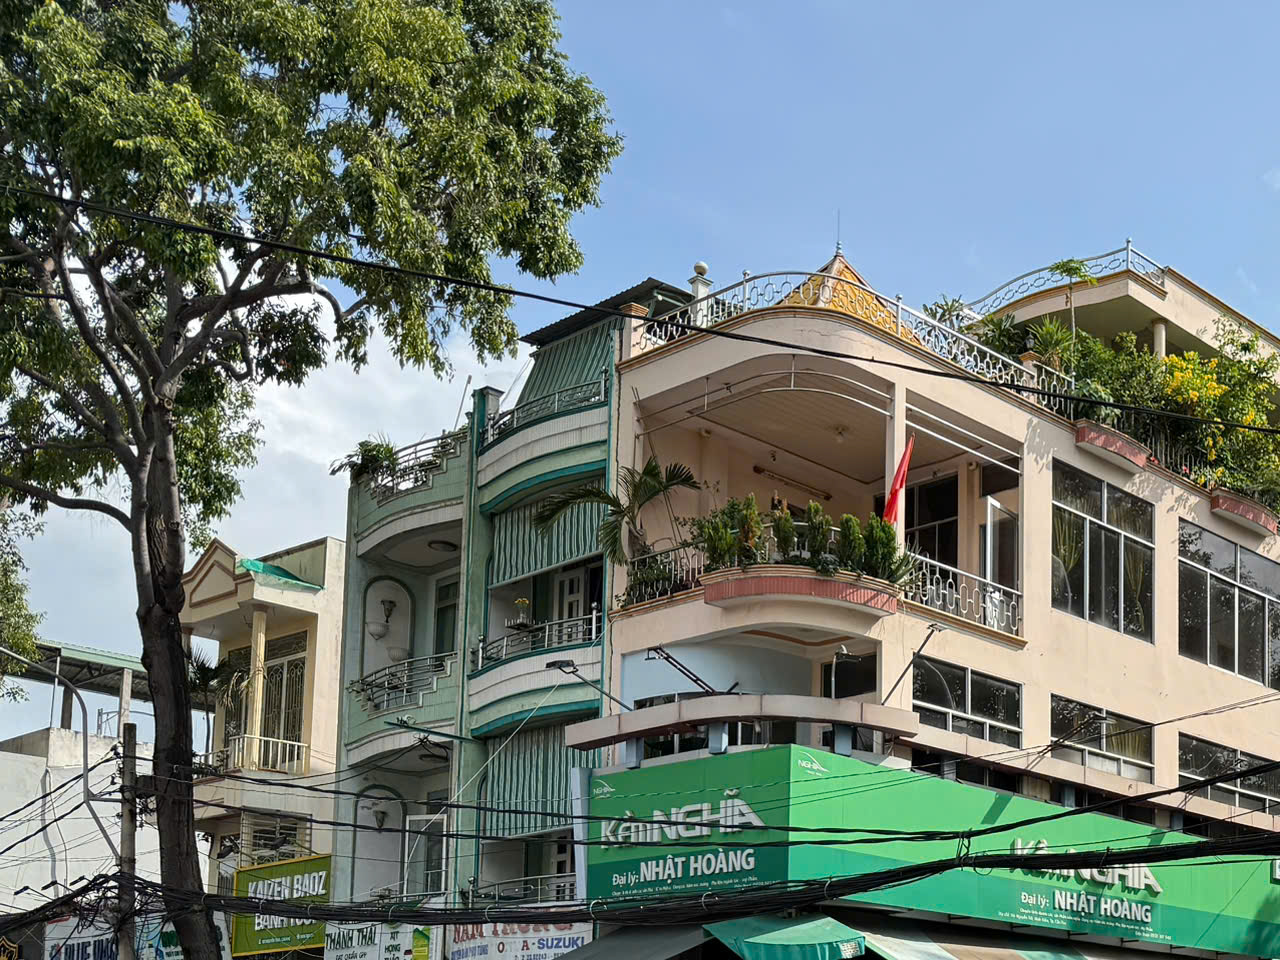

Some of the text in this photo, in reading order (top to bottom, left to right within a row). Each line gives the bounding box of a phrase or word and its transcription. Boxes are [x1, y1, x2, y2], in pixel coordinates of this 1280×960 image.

[612, 872, 627, 888] Đại
[640, 855, 687, 885] NHẬT
[689, 847, 756, 877] HOÀNG
[293, 871, 327, 898] BAOZ
[1021, 891, 1036, 907] Đại
[1053, 889, 1096, 917] NHẬT
[1099, 894, 1153, 924] HOÀNG
[538, 937, 586, 951] SUZUKI
